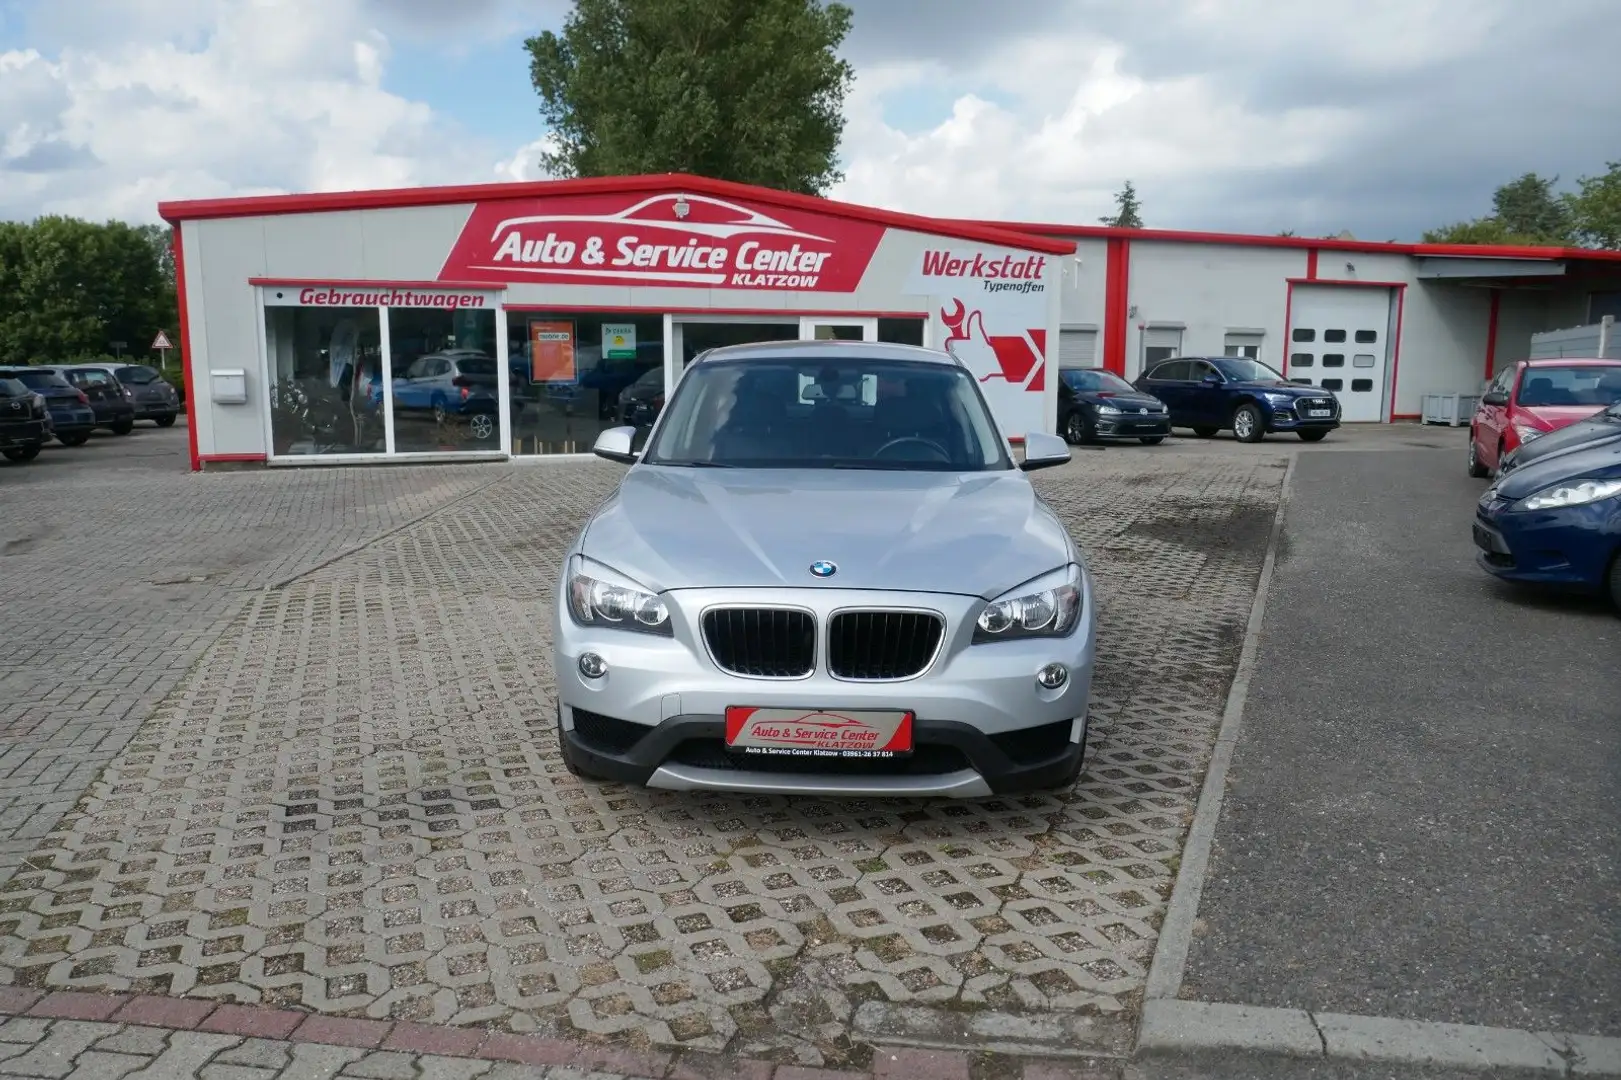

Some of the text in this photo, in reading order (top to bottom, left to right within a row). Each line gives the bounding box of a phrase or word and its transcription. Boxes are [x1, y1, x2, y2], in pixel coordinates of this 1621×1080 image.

[493, 231, 832, 273] Auto & Service Center
[922, 250, 1046, 279] Werkstatt
[731, 273, 818, 287] KLATZOW
[983, 280, 1044, 293] Typenoffen
[300, 288, 484, 311] Gebrauchtwagen
[752, 726, 879, 740] Auto & Service Center
[768, 747, 791, 755] Service
[792, 748, 813, 756] Center
